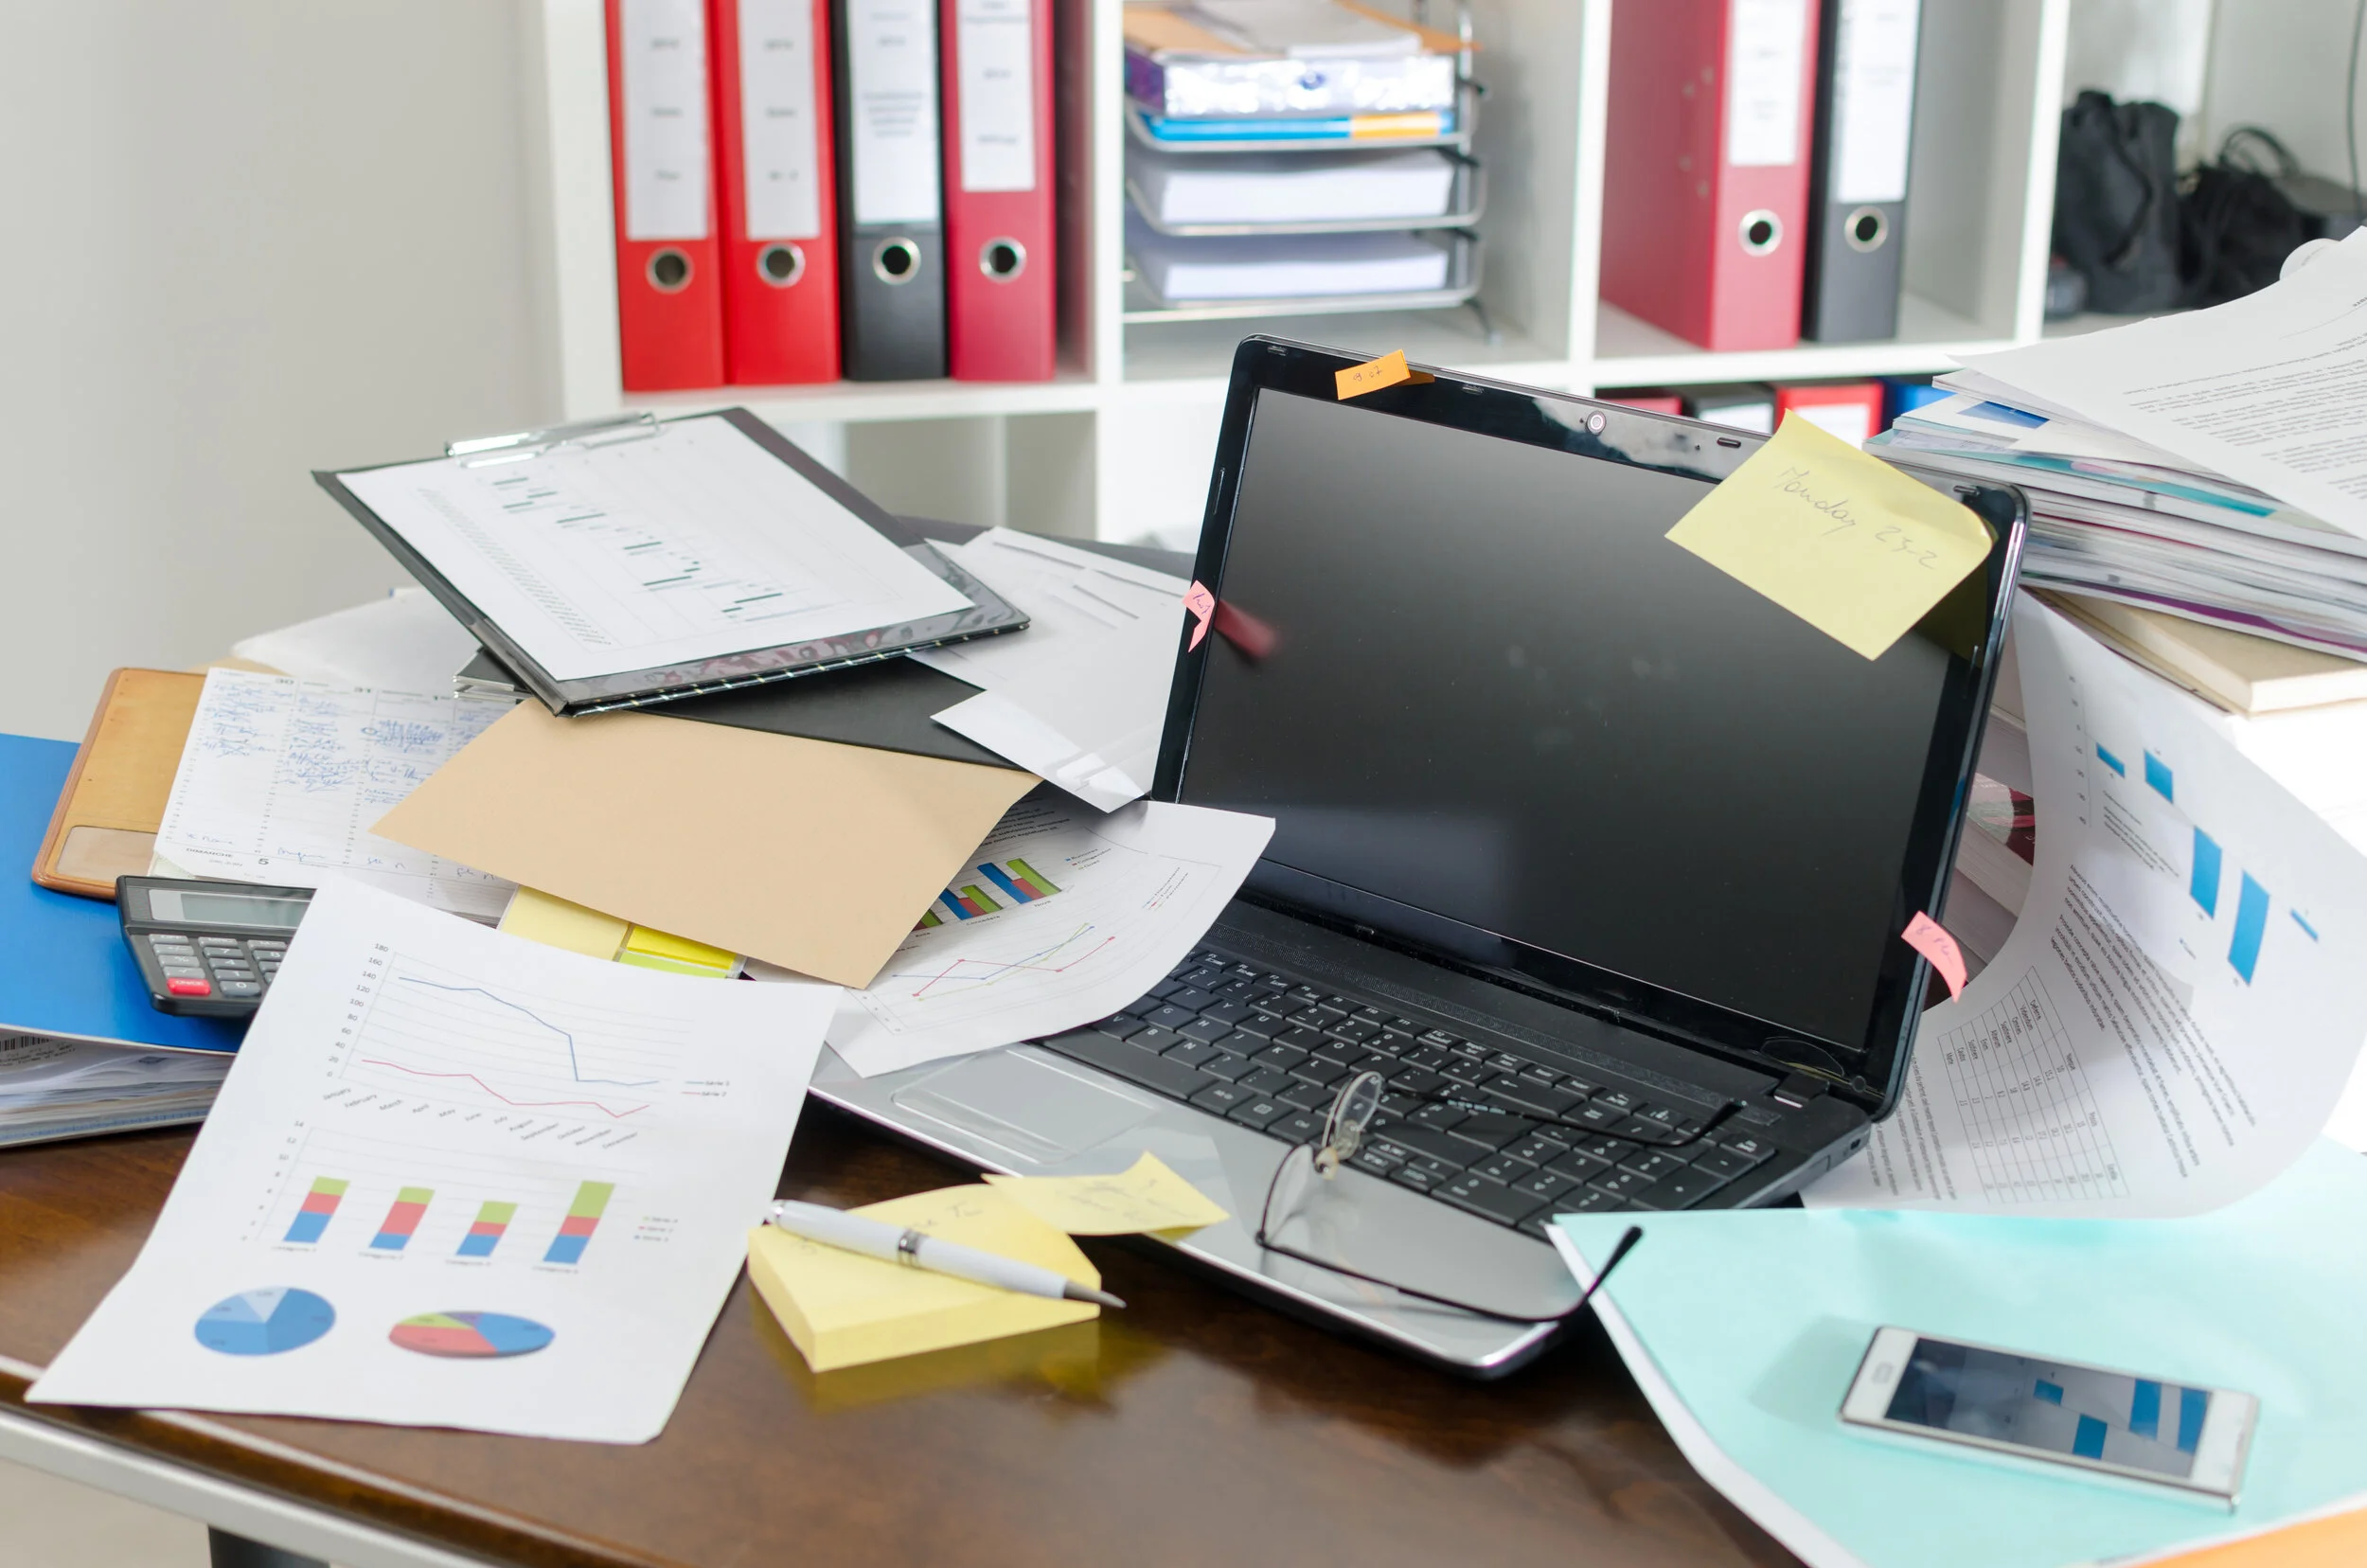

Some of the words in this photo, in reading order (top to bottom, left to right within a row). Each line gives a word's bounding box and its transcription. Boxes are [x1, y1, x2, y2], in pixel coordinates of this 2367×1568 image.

[187, 848, 233, 858] DIMANCHE
[375, 943, 389, 953] 180
[368, 956, 383, 966] 160
[362, 971, 376, 979] 140
[356, 984, 370, 993] 120
[349, 998, 364, 1007] 100
[2028, 998, 2042, 1022] Deferre
[341, 1026, 351, 1035] 60
[335, 1041, 346, 1049] 40
[344, 1094, 377, 1109] February
[379, 1098, 403, 1111] March
[521, 1123, 559, 1140] September
